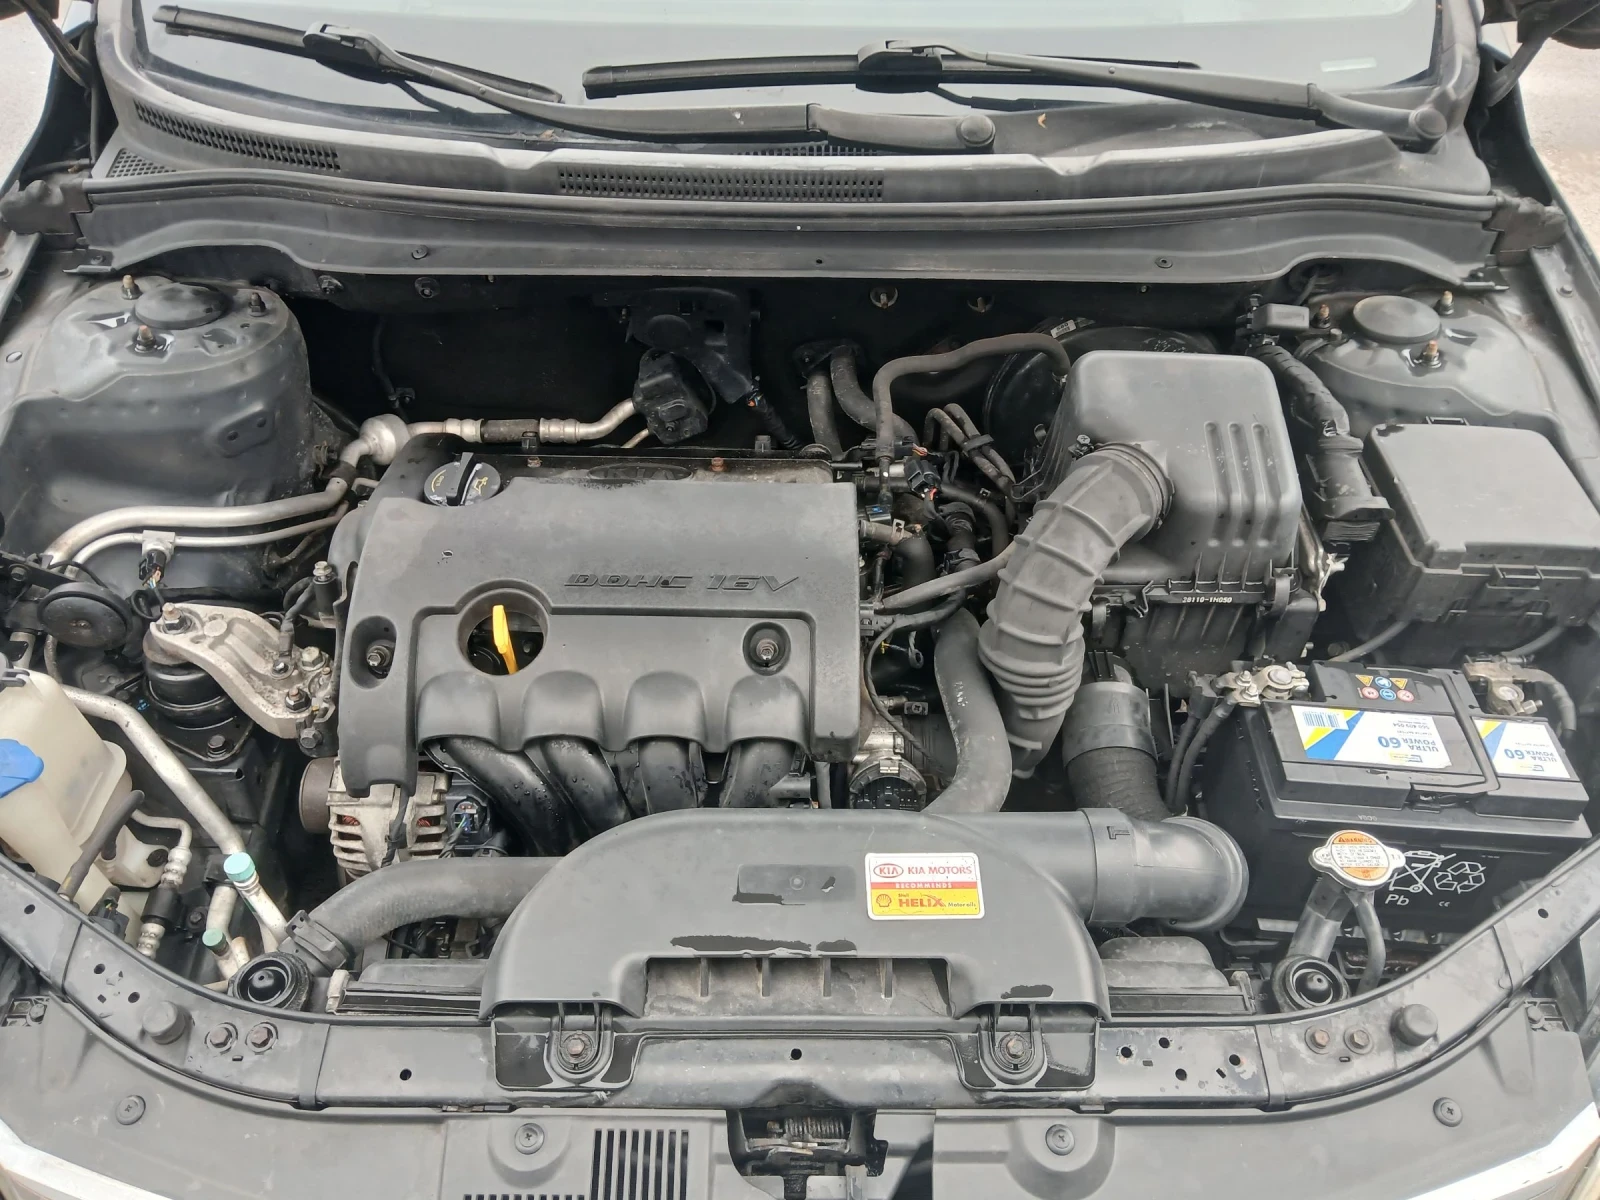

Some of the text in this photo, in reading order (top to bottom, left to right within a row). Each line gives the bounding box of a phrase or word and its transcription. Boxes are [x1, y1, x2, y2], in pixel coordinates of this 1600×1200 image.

[564, 573, 799, 591] DOHC 16V
[1377, 735, 1436, 749] POWER 60
[1407, 744, 1439, 752] ULTRA
[1504, 748, 1555, 760] POWER 60
[879, 866, 972, 875] KIA KIA MOTORS
[898, 898, 945, 908] HELIX
[1385, 894, 1409, 905] Pb
